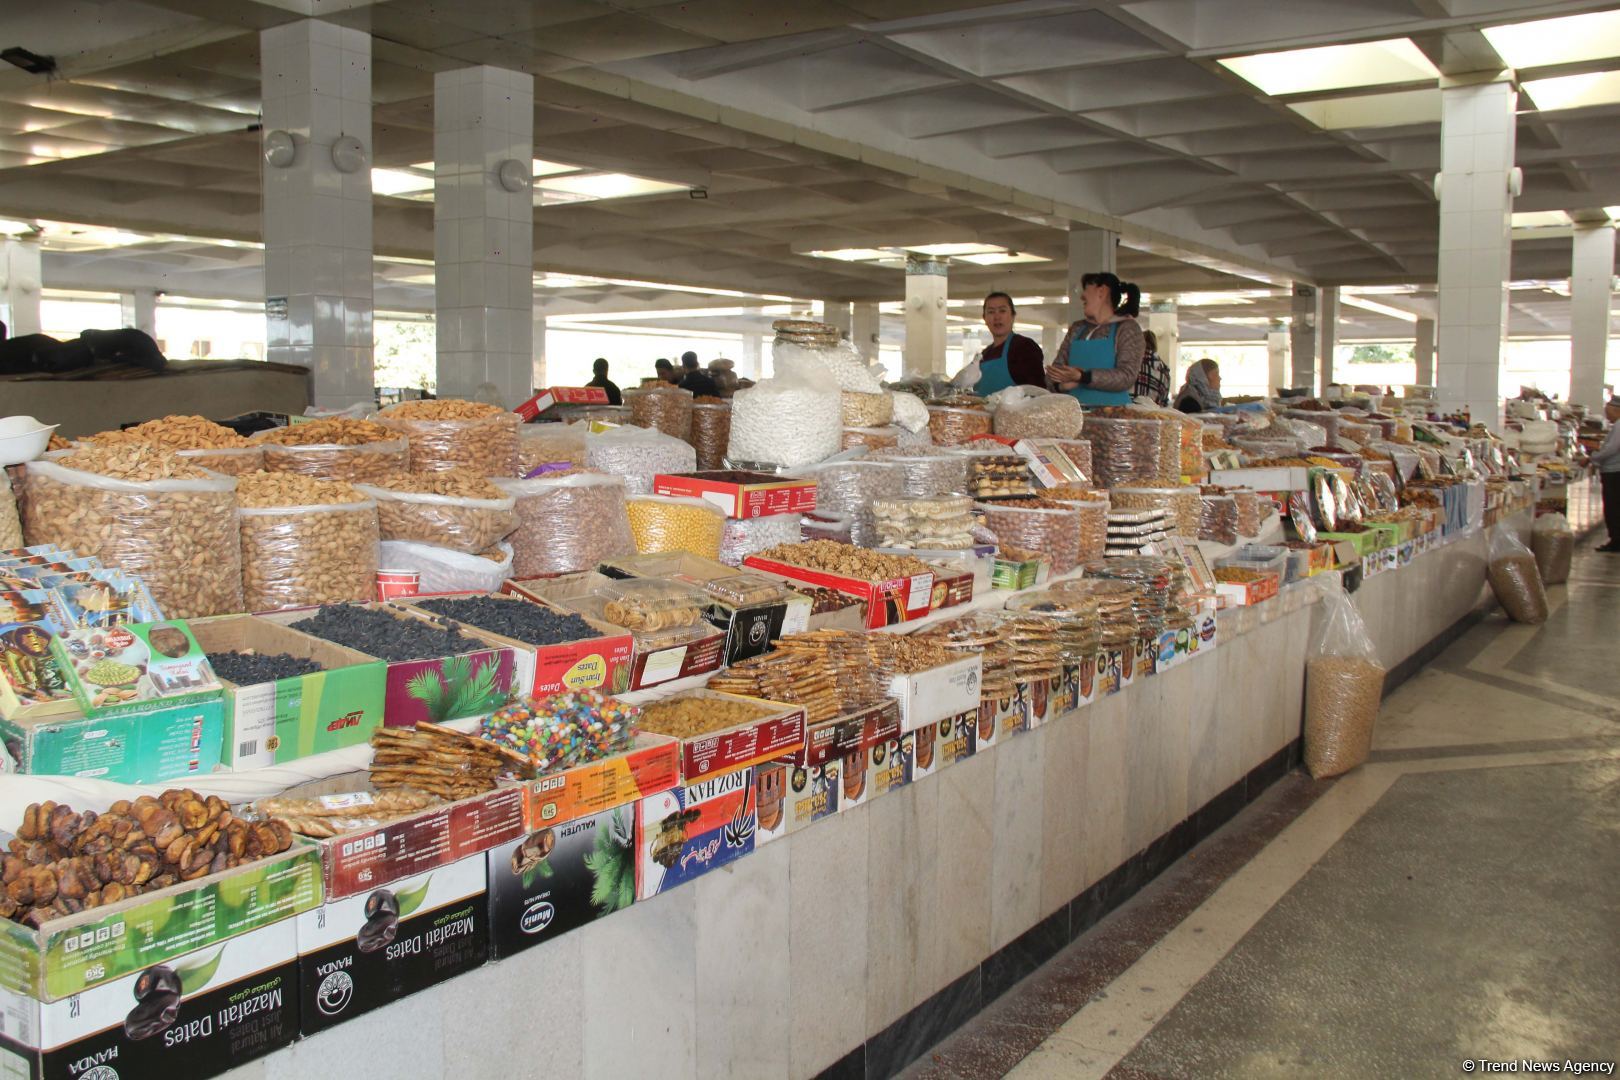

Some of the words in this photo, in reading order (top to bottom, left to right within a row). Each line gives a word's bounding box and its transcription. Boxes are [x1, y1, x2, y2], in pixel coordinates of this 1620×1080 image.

[577, 662, 598, 671] Dates
[570, 676, 585, 685] Sun
[585, 673, 600, 681] Iran
[540, 682, 561, 692] Dates
[560, 819, 596, 839] KALUTEH
[524, 908, 551, 927] Munis
[425, 916, 474, 952] Mazafati
[386, 935, 421, 961] Dates
[218, 988, 283, 1032] Mazafati
[164, 1014, 213, 1048] Dates
